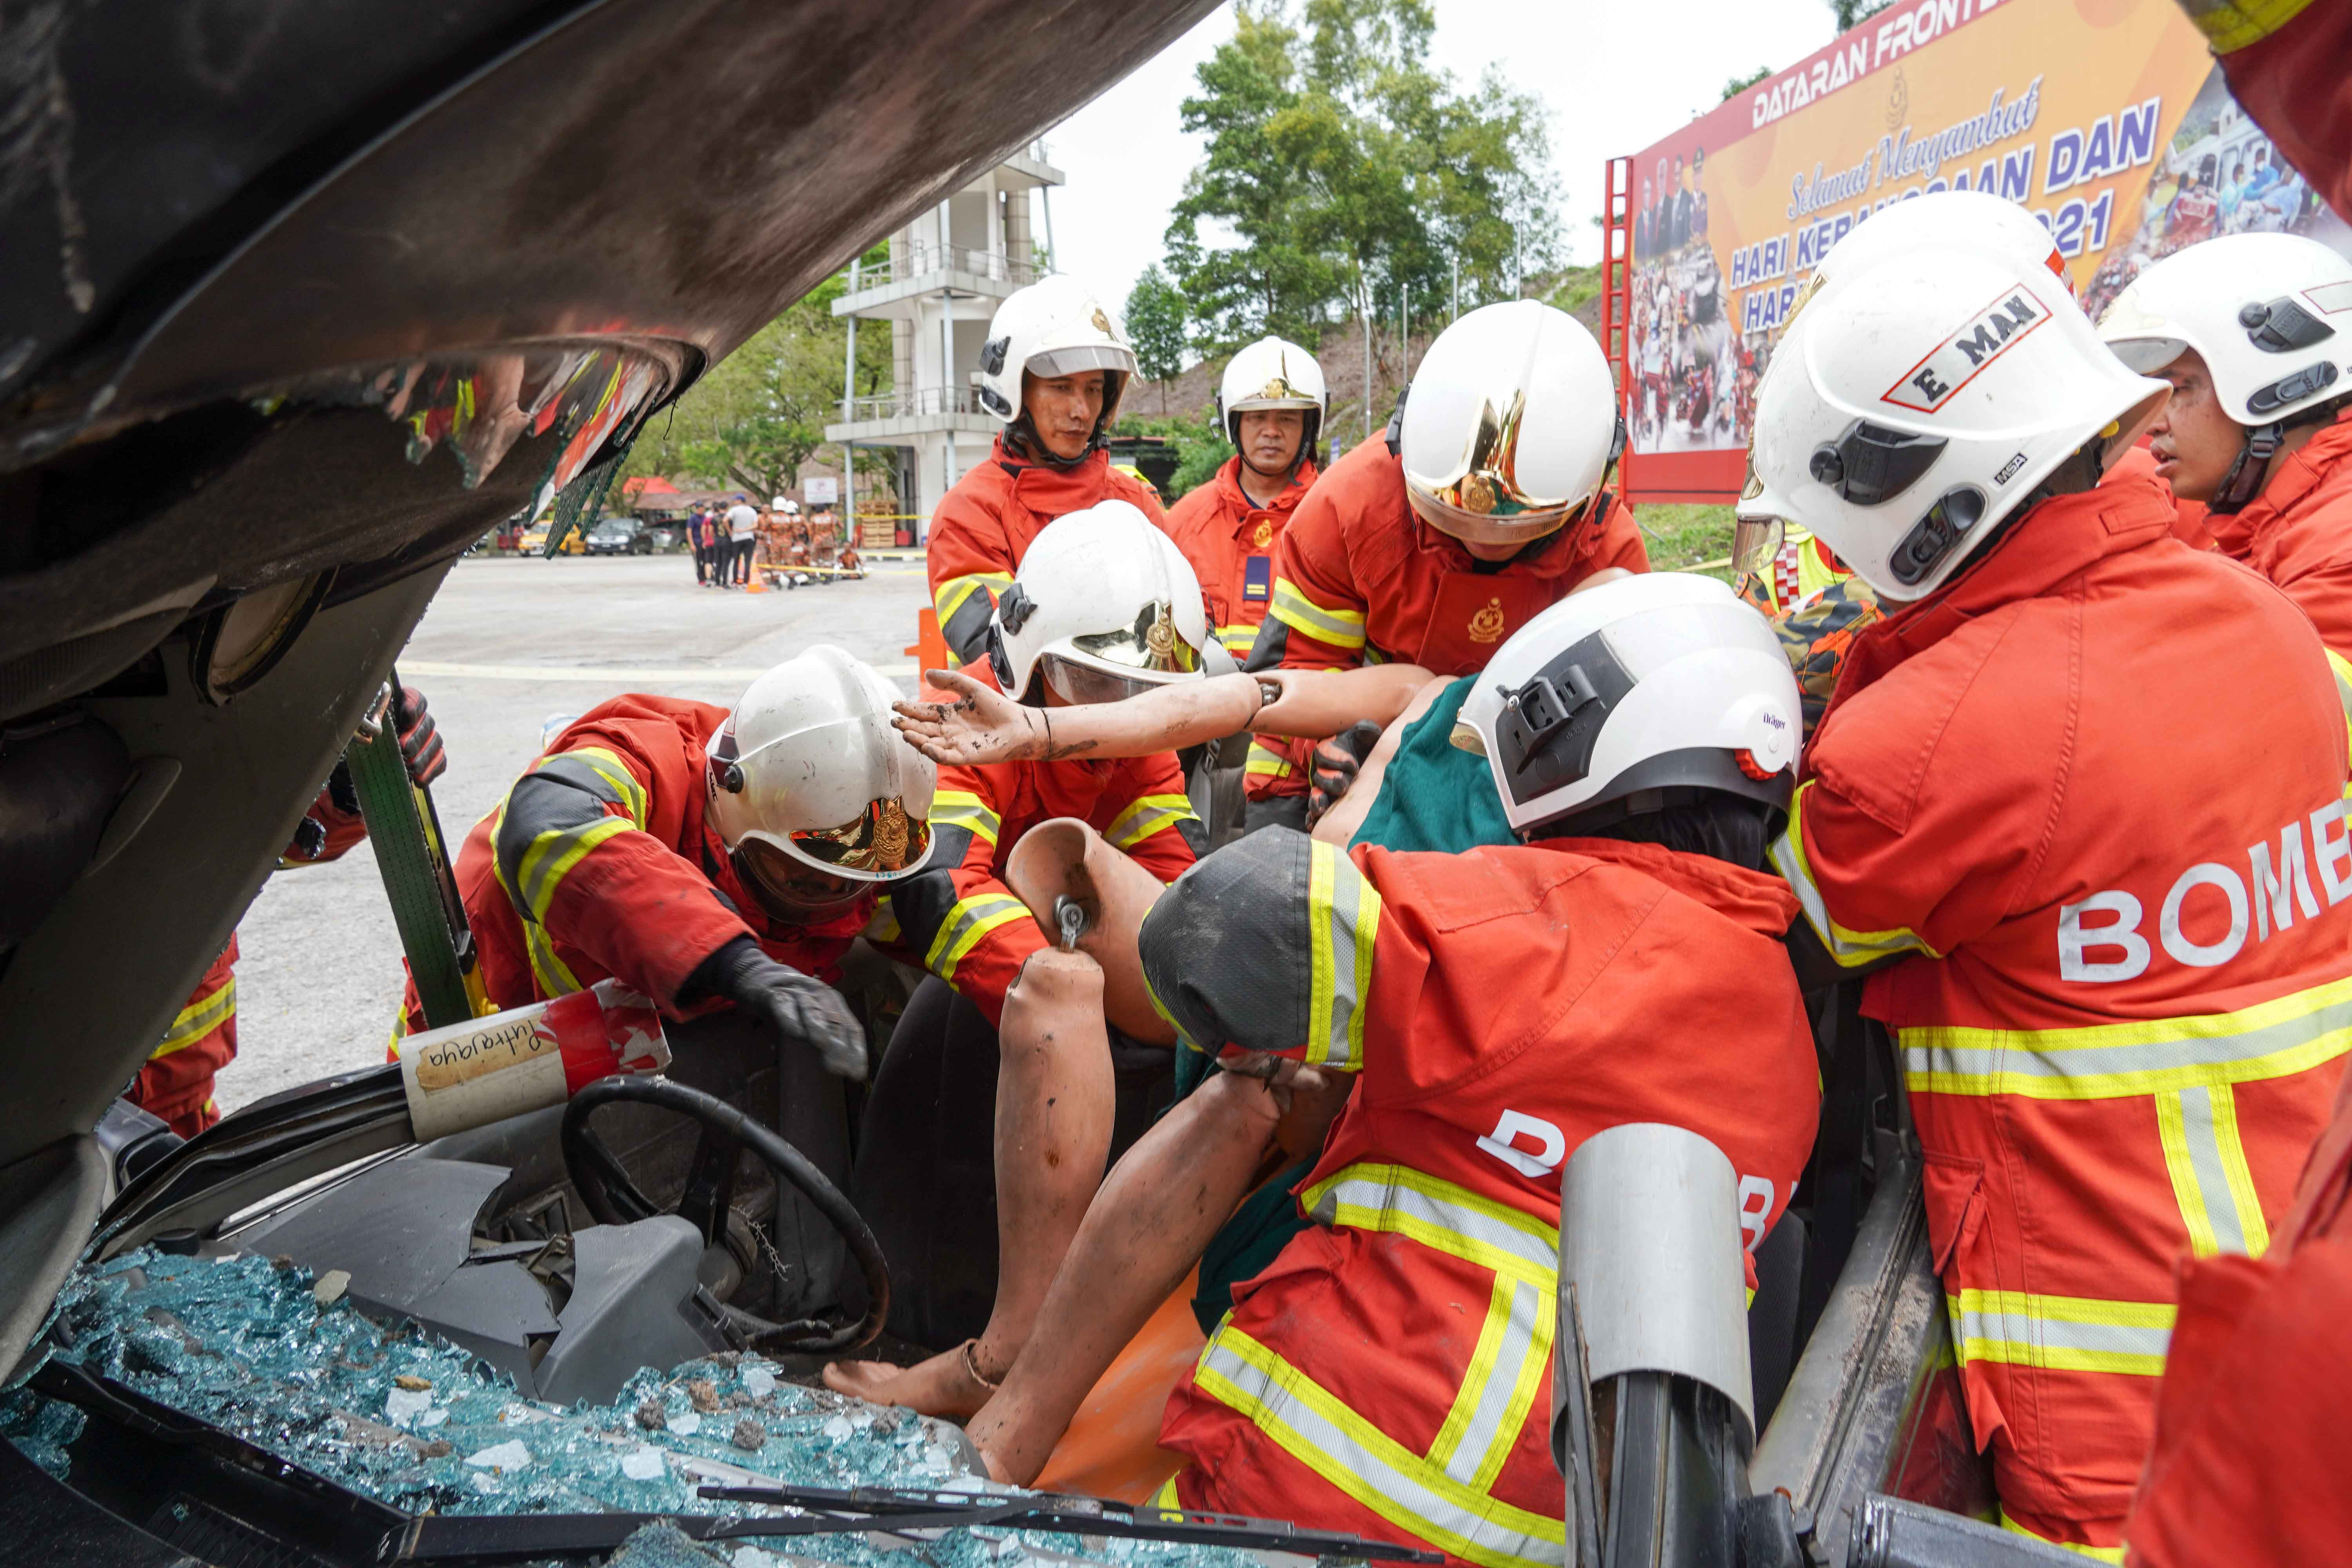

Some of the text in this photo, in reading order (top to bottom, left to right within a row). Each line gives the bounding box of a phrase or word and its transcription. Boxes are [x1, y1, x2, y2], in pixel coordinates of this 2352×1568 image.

[1752, 0, 1998, 129] DATARAN FRON
[1731, 234, 1789, 289] HARI
[2044, 97, 2160, 194] DAN
[1787, 74, 2043, 220] Selamat Menyambut
[1744, 280, 1806, 333] HAR
[1913, 295, 2037, 403] E MAN
[1994, 453, 2028, 485] MSA
[430, 1020, 541, 1066] Putrajaya
